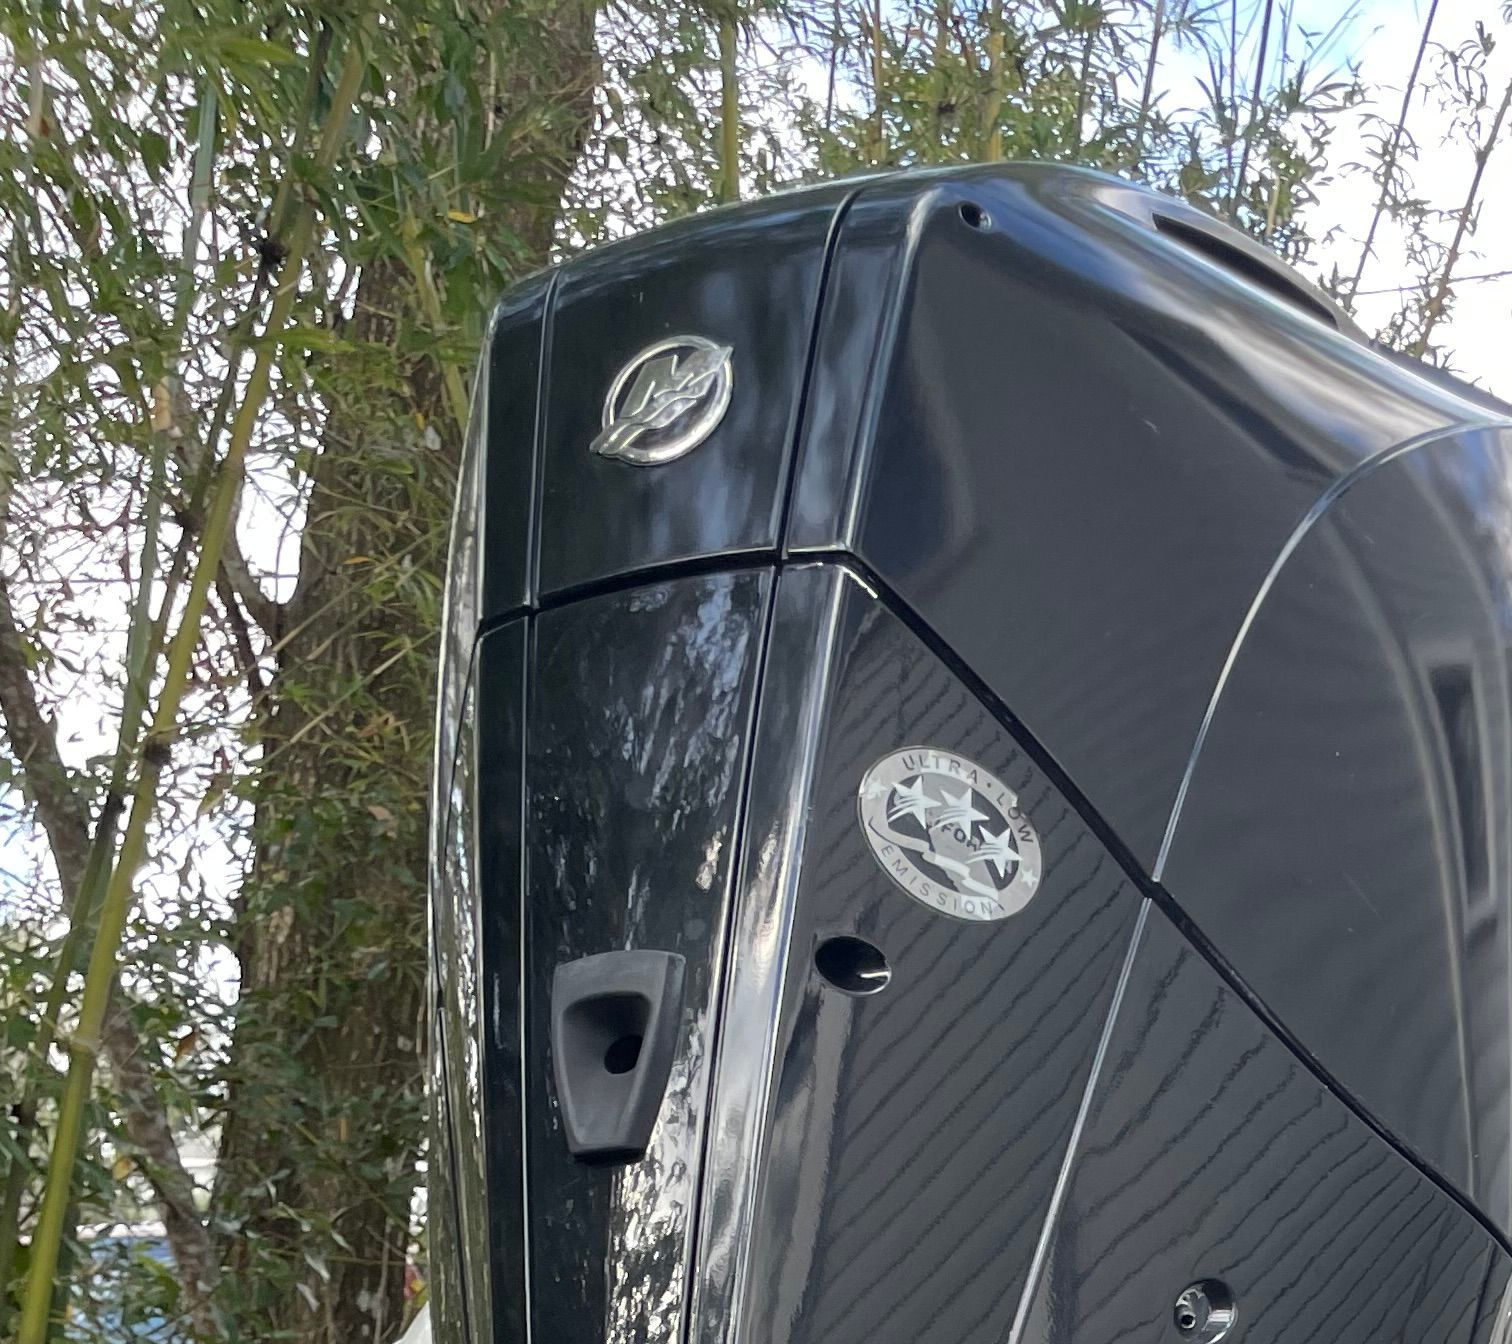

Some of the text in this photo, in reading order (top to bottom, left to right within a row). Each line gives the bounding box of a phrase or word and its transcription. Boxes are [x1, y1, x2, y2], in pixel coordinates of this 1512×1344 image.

[901, 754, 978, 784] ULTRA
[997, 792, 1034, 844] LOW
[880, 845, 994, 915] EMISSION
